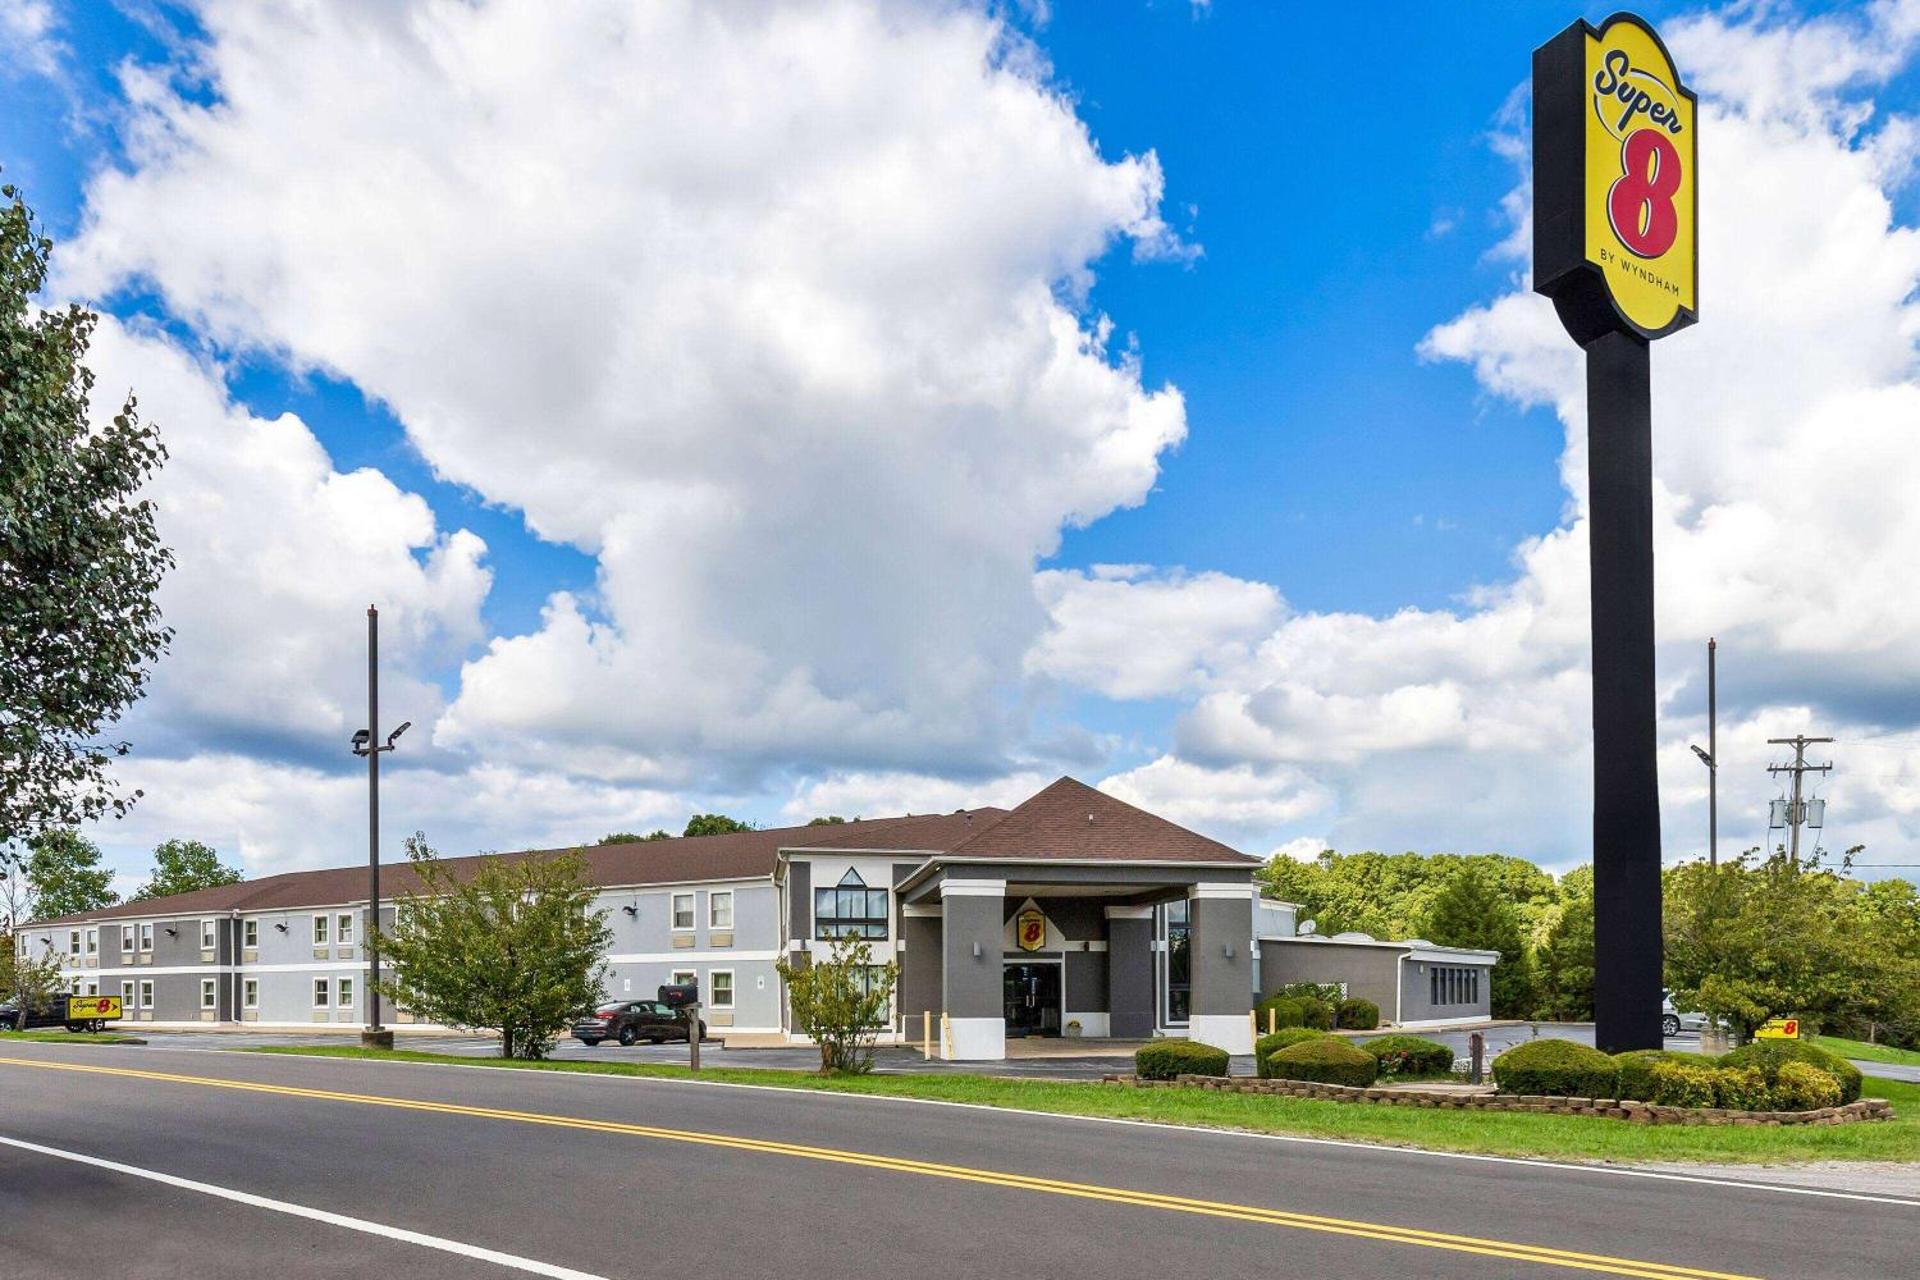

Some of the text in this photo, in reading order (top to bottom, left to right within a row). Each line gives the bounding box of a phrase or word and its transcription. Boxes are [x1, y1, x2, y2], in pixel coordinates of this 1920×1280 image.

[1595, 49, 1682, 134] Super
[1607, 128, 1682, 258] 8
[1600, 248, 1679, 296] BY WYNDHAM
[1024, 922, 1041, 942] 8
[96, 998, 110, 1013] 8
[1784, 1021, 1796, 1034] 8
